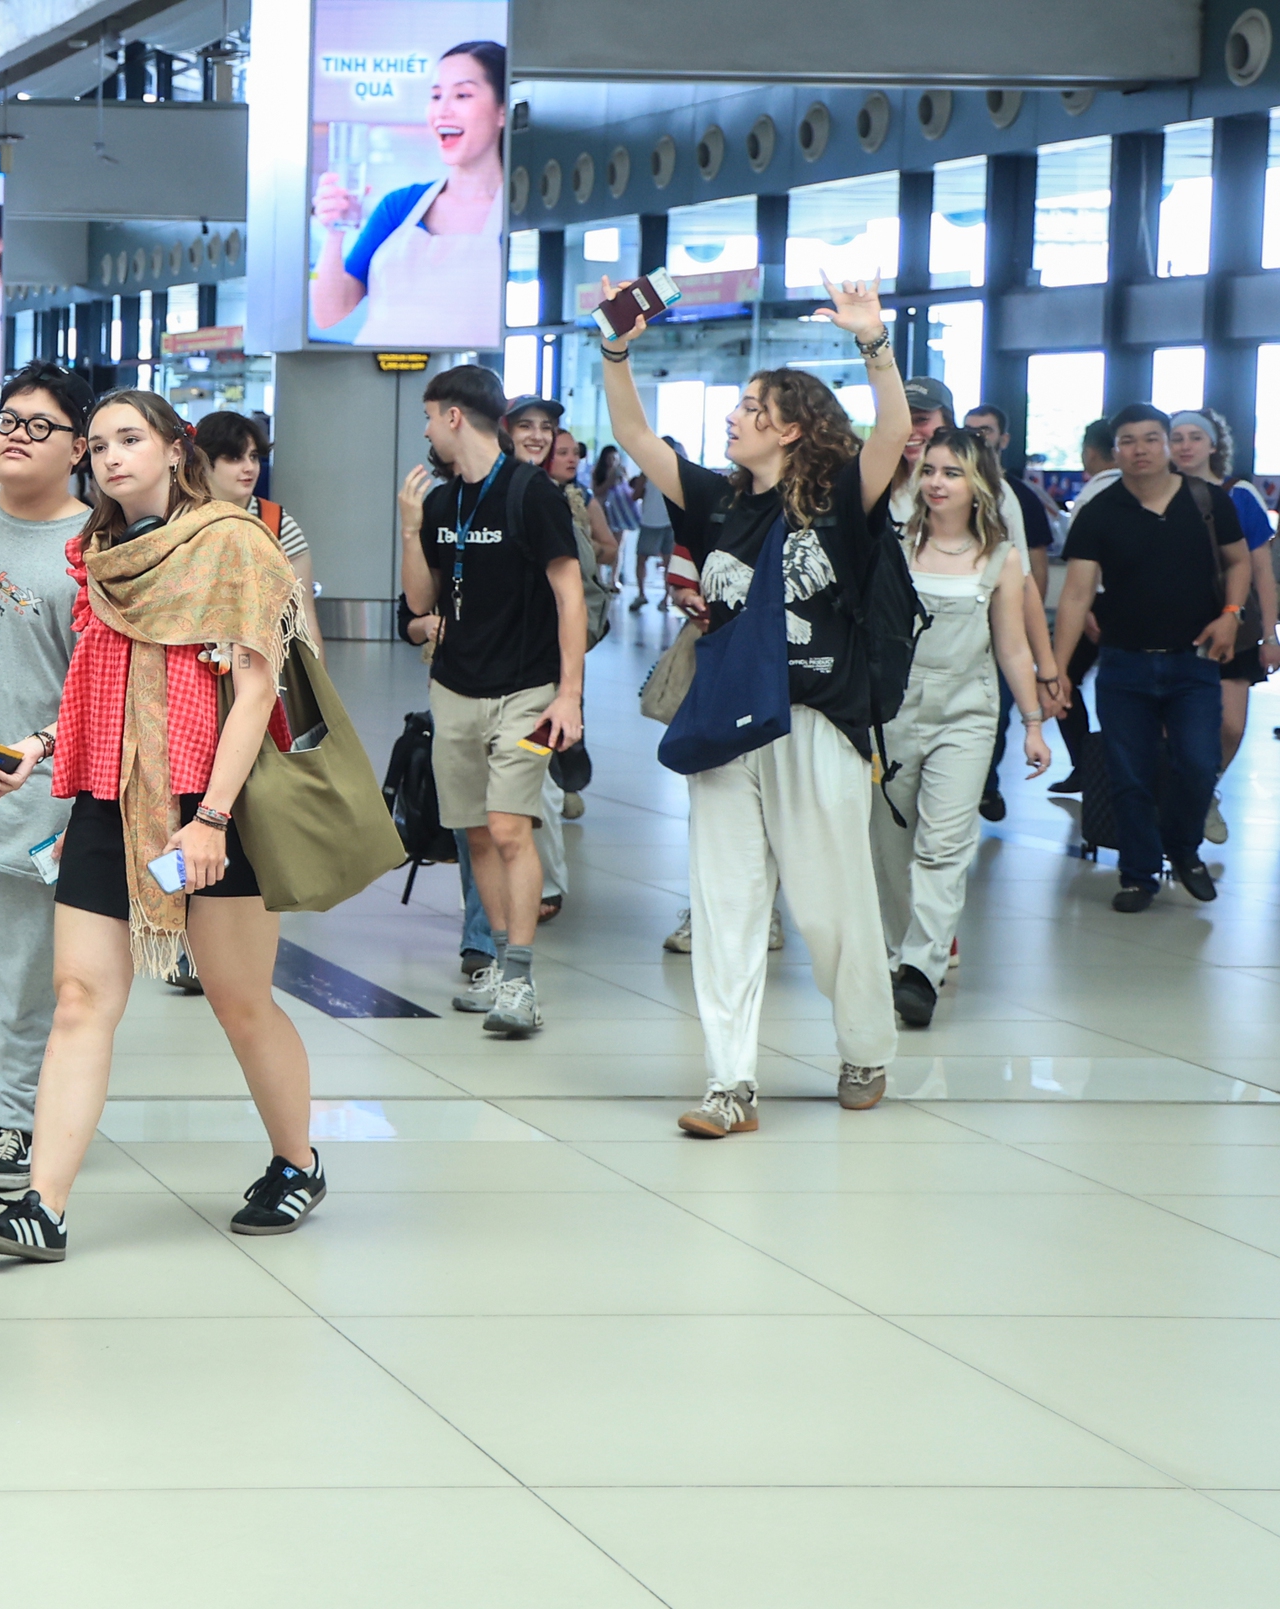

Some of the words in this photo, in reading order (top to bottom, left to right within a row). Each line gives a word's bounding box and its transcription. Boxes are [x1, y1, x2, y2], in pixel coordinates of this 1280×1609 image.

[322, 57, 366, 72] TINH
[373, 52, 428, 73] KHIẾT
[355, 78, 394, 101] QUÁ
[436, 526, 503, 544] Tenics
